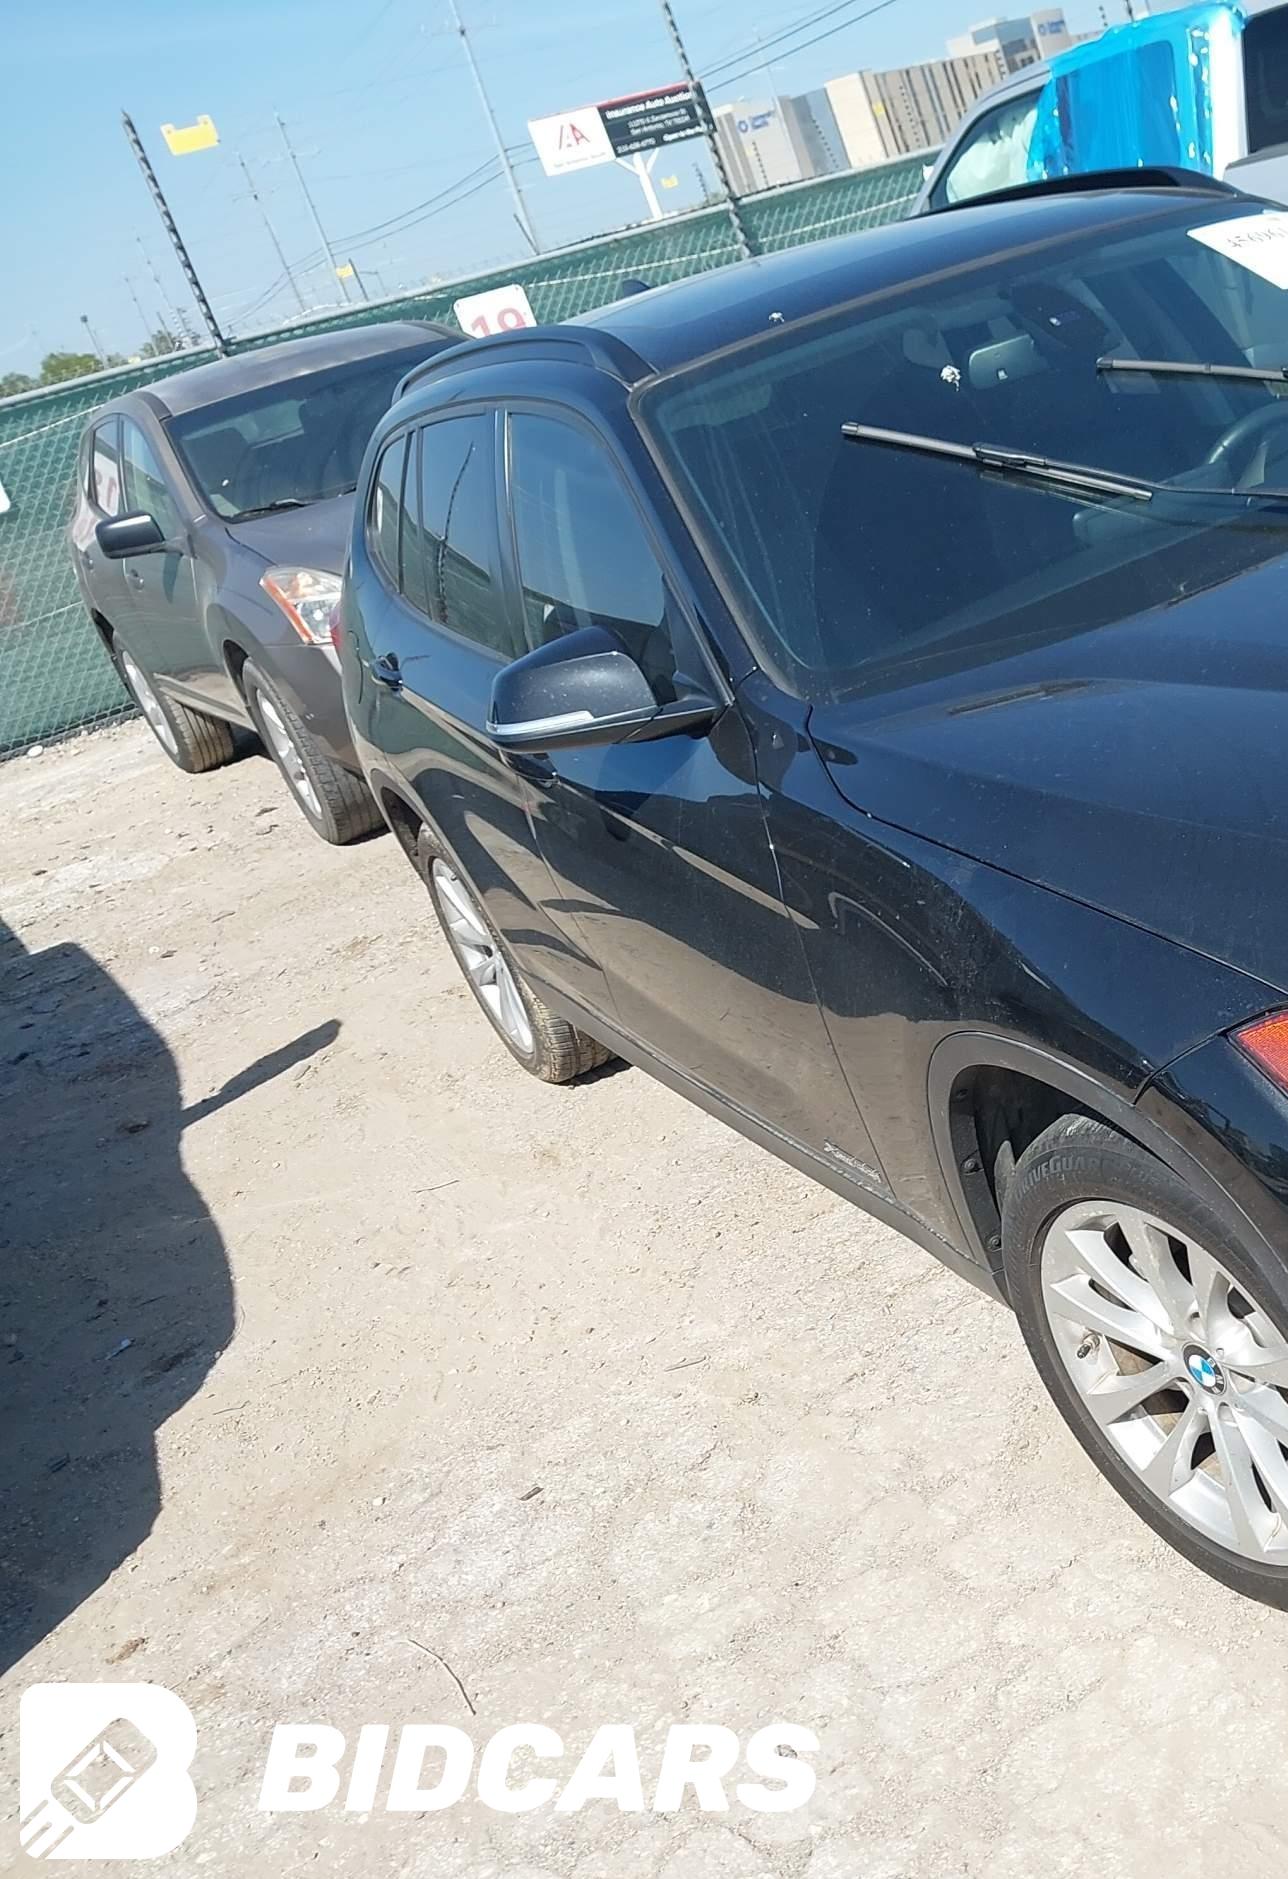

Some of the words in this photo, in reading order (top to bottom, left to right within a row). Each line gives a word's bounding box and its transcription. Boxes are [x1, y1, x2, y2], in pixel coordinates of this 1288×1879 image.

[605, 104, 645, 119] Insurance
[646, 99, 664, 109] Auto
[665, 91, 693, 105] Auction
